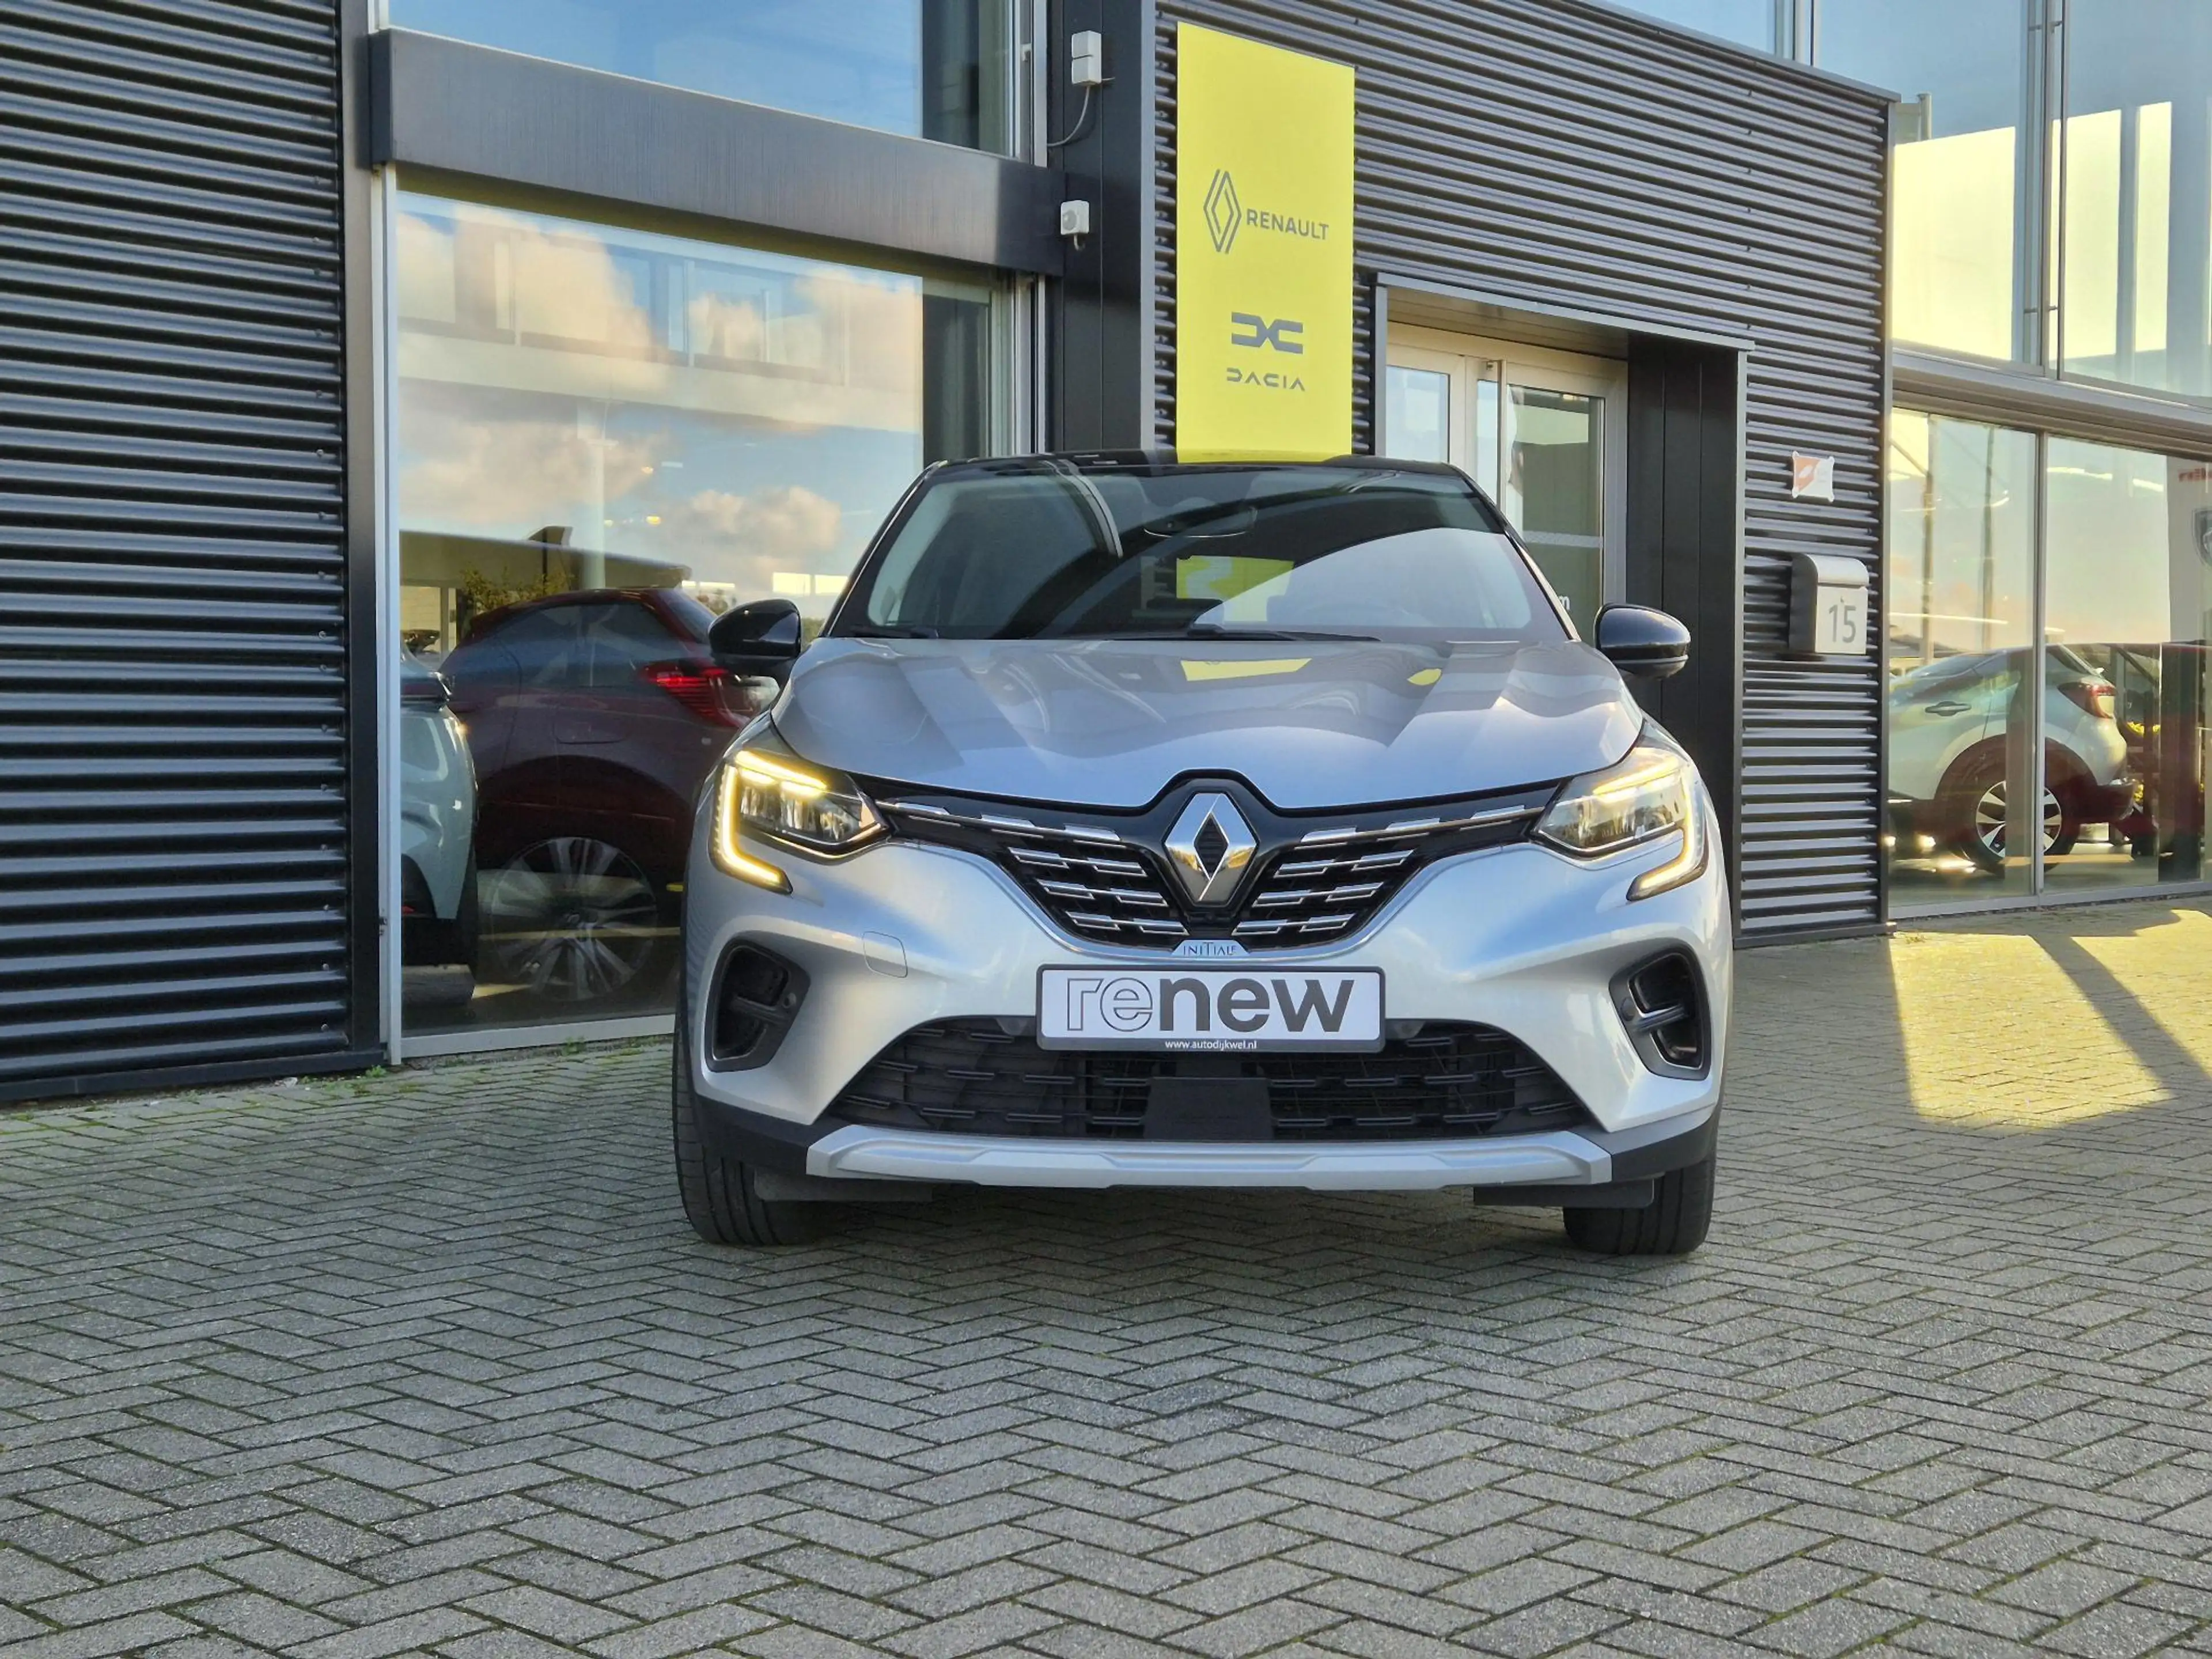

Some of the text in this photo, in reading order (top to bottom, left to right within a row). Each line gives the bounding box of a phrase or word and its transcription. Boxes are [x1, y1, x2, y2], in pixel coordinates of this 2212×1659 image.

[1247, 209, 1329, 240] RENAULT
[1226, 368, 1305, 391] DACIA
[1828, 604, 1857, 643] 15
[1067, 978, 1354, 1032] renew
[1165, 1040, 1257, 1051] www.autodijkwel.nl
